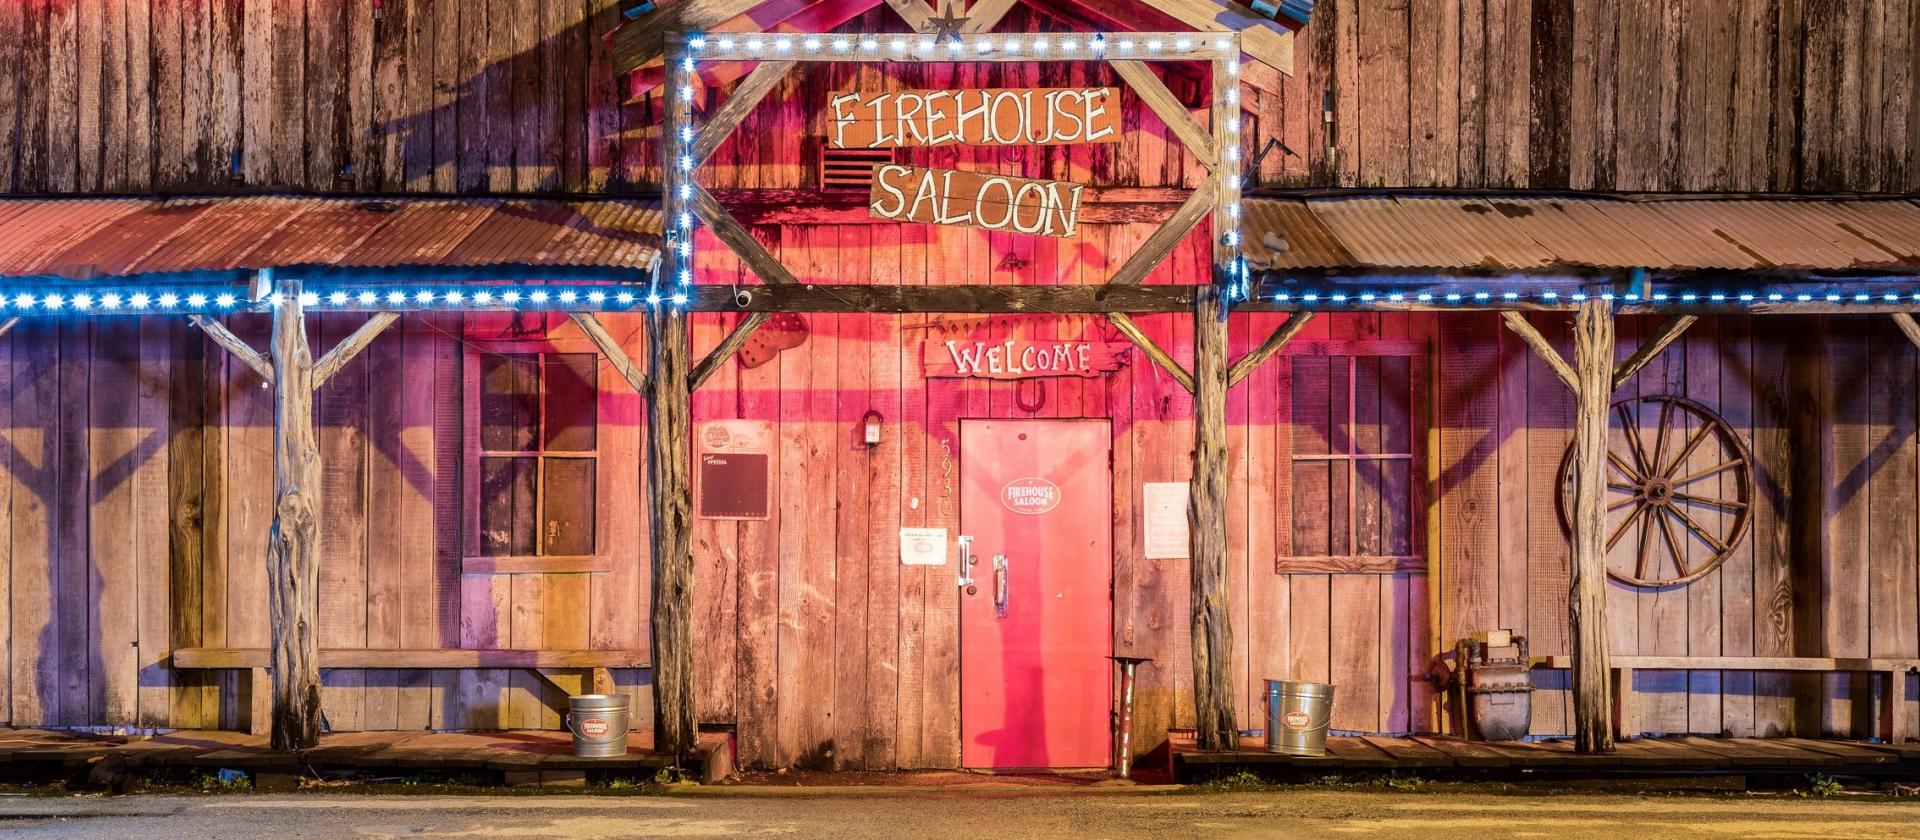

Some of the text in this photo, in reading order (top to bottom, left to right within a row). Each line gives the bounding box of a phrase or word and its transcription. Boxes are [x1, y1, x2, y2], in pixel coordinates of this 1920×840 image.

[831, 88, 1114, 148] FIREHOUSE
[870, 164, 1085, 238] SALOON
[945, 340, 1092, 374] WELCOME
[1007, 486, 1054, 500] FIREHOUSE
[1014, 497, 1048, 506] SALOON
